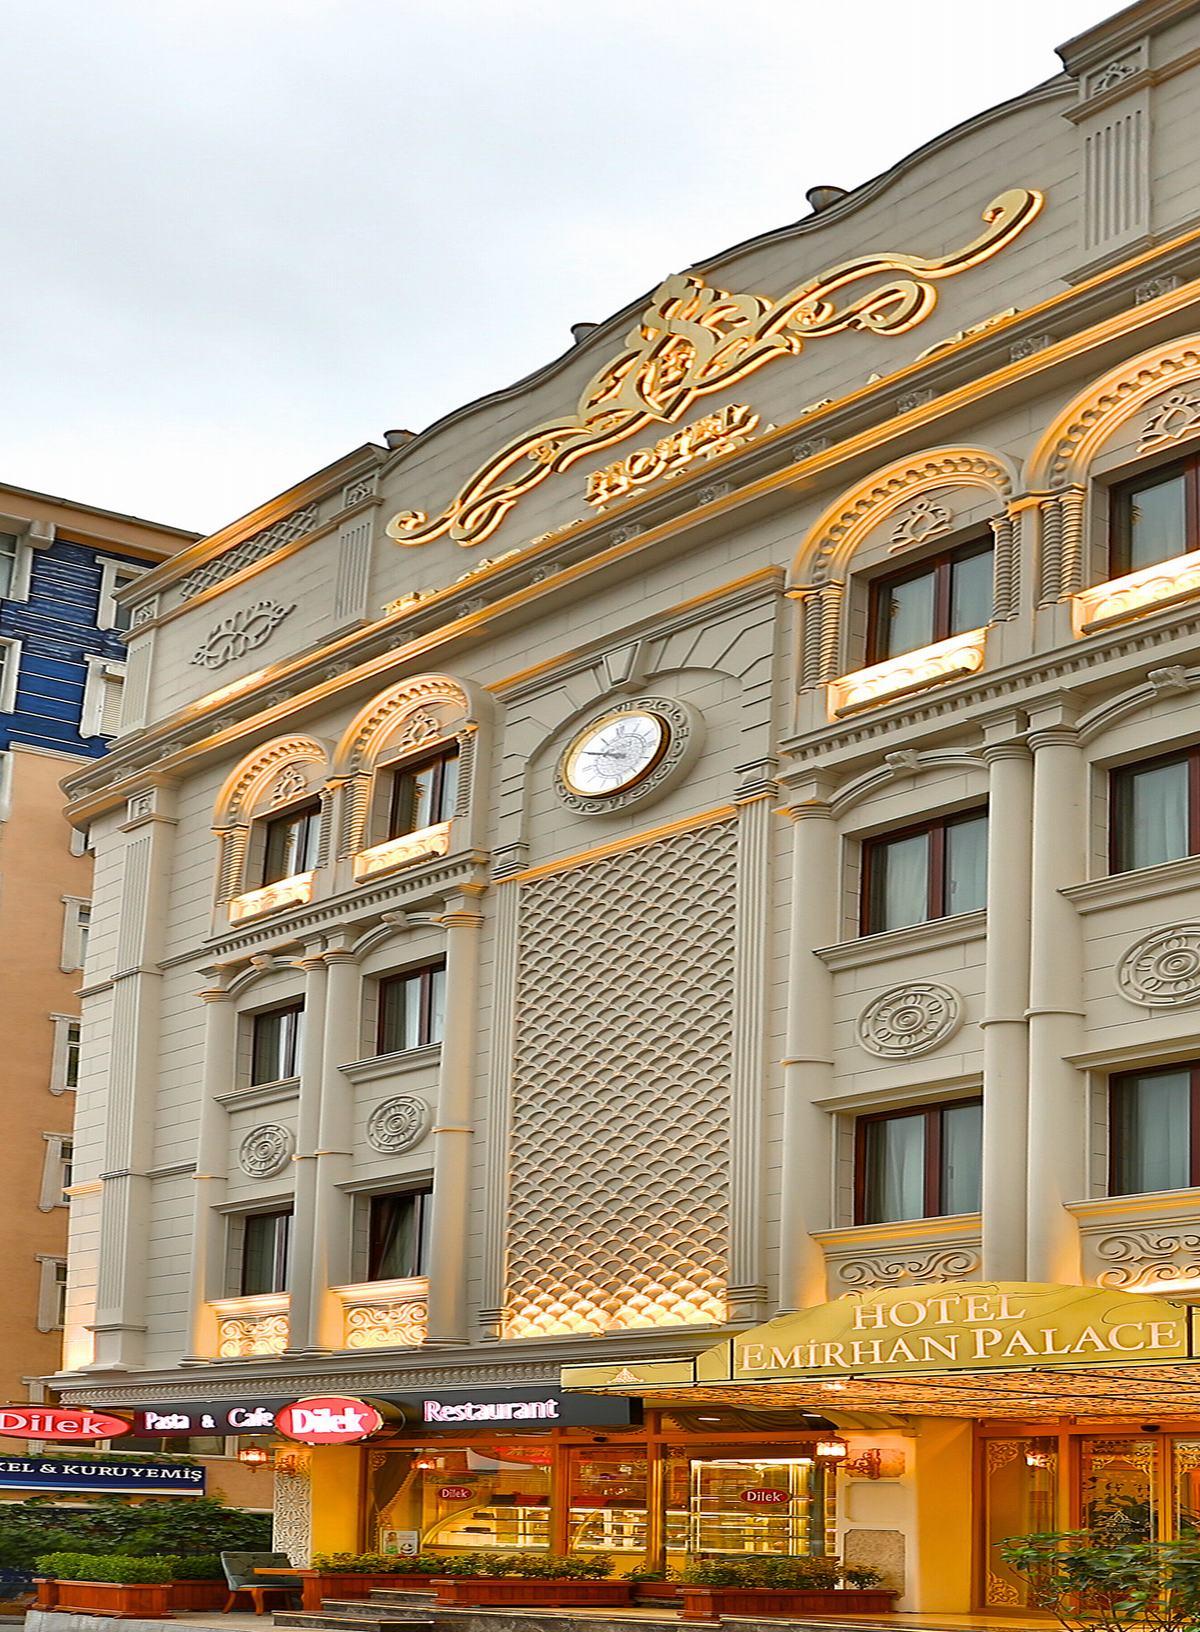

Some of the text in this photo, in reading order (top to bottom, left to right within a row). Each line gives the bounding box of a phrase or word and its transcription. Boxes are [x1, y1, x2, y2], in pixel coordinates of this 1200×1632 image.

[583, 403, 760, 506] HOTEL
[852, 1293, 1025, 1330] HOTEL
[738, 1320, 1182, 1371] EMİRHAN PALACE
[145, 1411, 190, 1430] Pasta
[201, 1413, 216, 1429] &
[291, 1408, 366, 1433] Dilek
[424, 1398, 560, 1422] Restaurant
[0, 1413, 105, 1435] Dilek
[39, 1463, 58, 1474] &
[62, 1465, 202, 1482] KURUYEMİŞ
[441, 1488, 469, 1498] Dilek
[746, 1489, 783, 1504] Dilek
